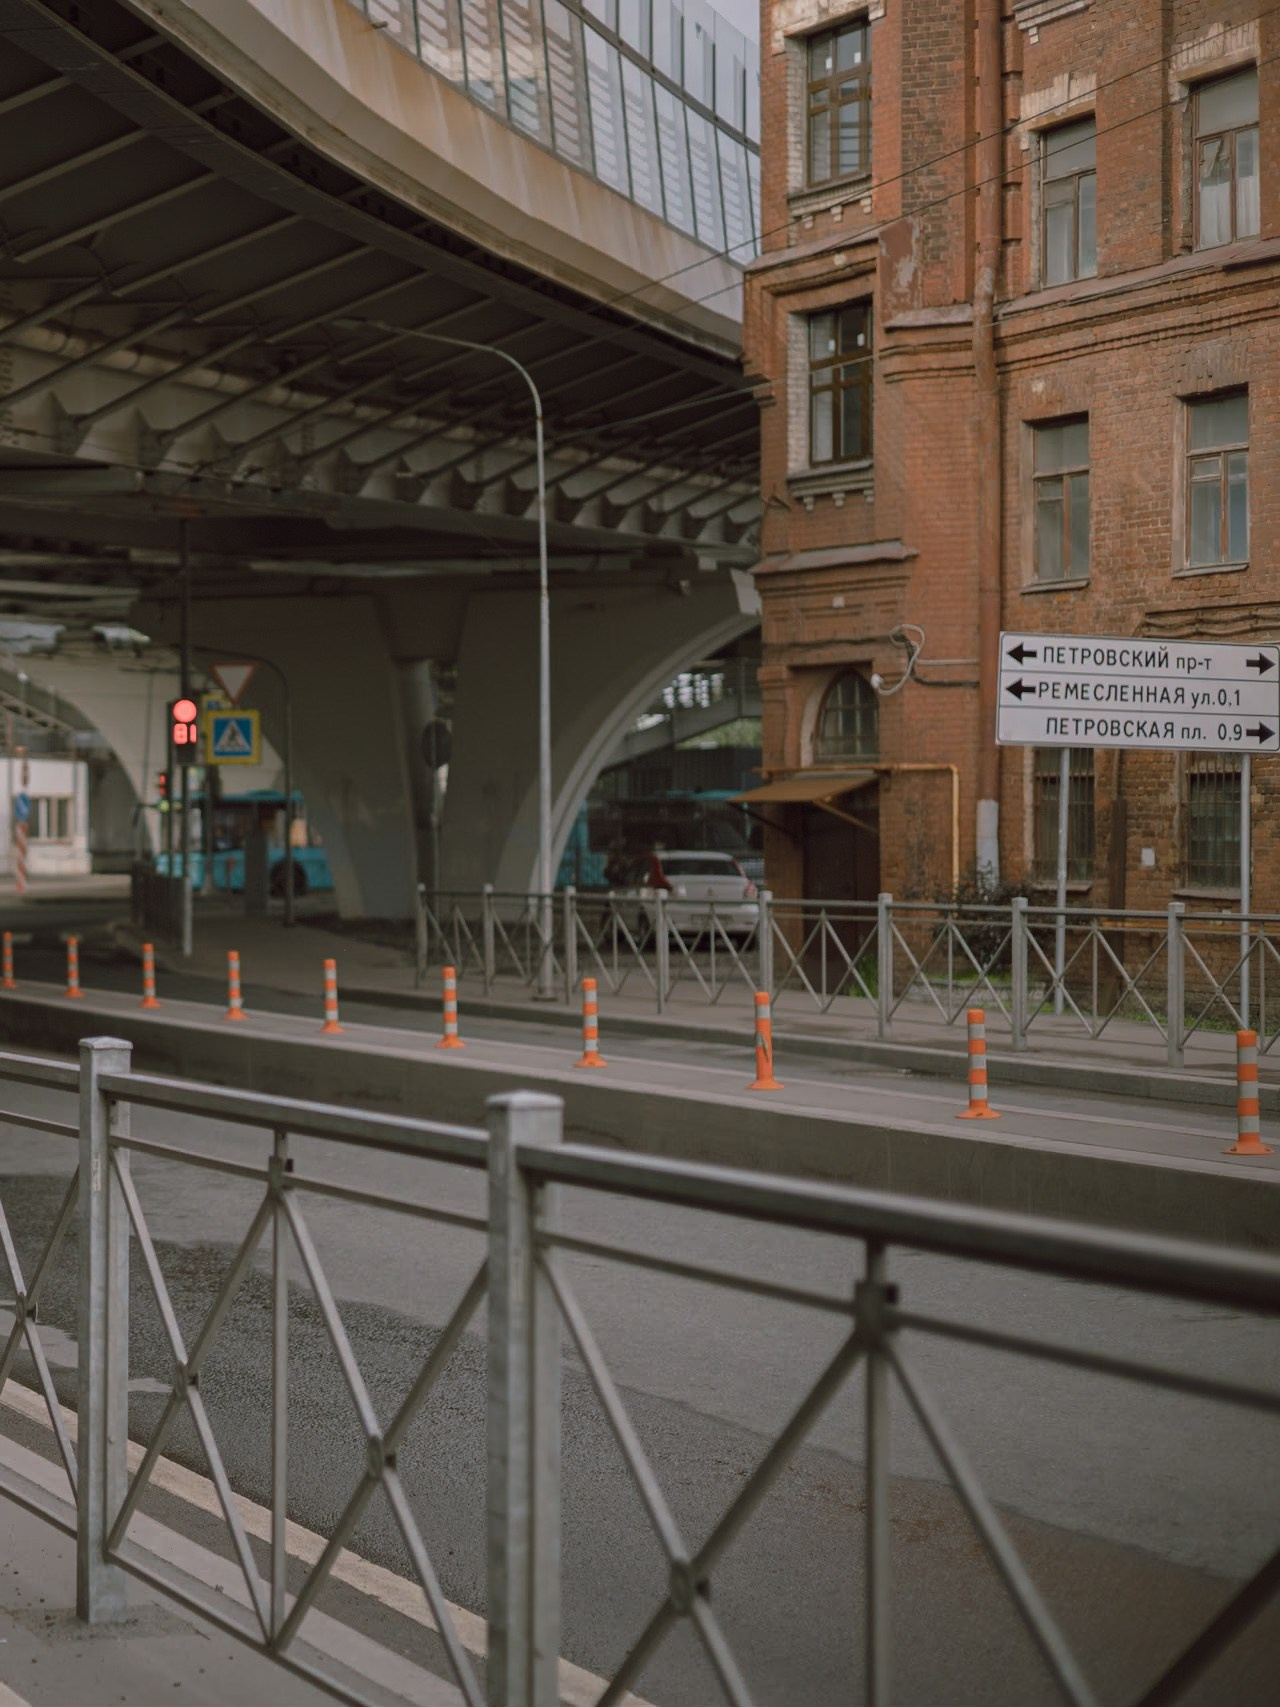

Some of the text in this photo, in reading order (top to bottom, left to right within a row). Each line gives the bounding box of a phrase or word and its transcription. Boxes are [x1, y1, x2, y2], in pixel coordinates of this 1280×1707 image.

[1042, 645, 1212, 674] ПЕТРОВСКИЙ пр-т
[1038, 681, 1185, 704] РЕМЕСЛЕННАЯ
[1046, 717, 1174, 738] ПЕТРОВСКАЯ
[1181, 726, 1207, 740] пл.
